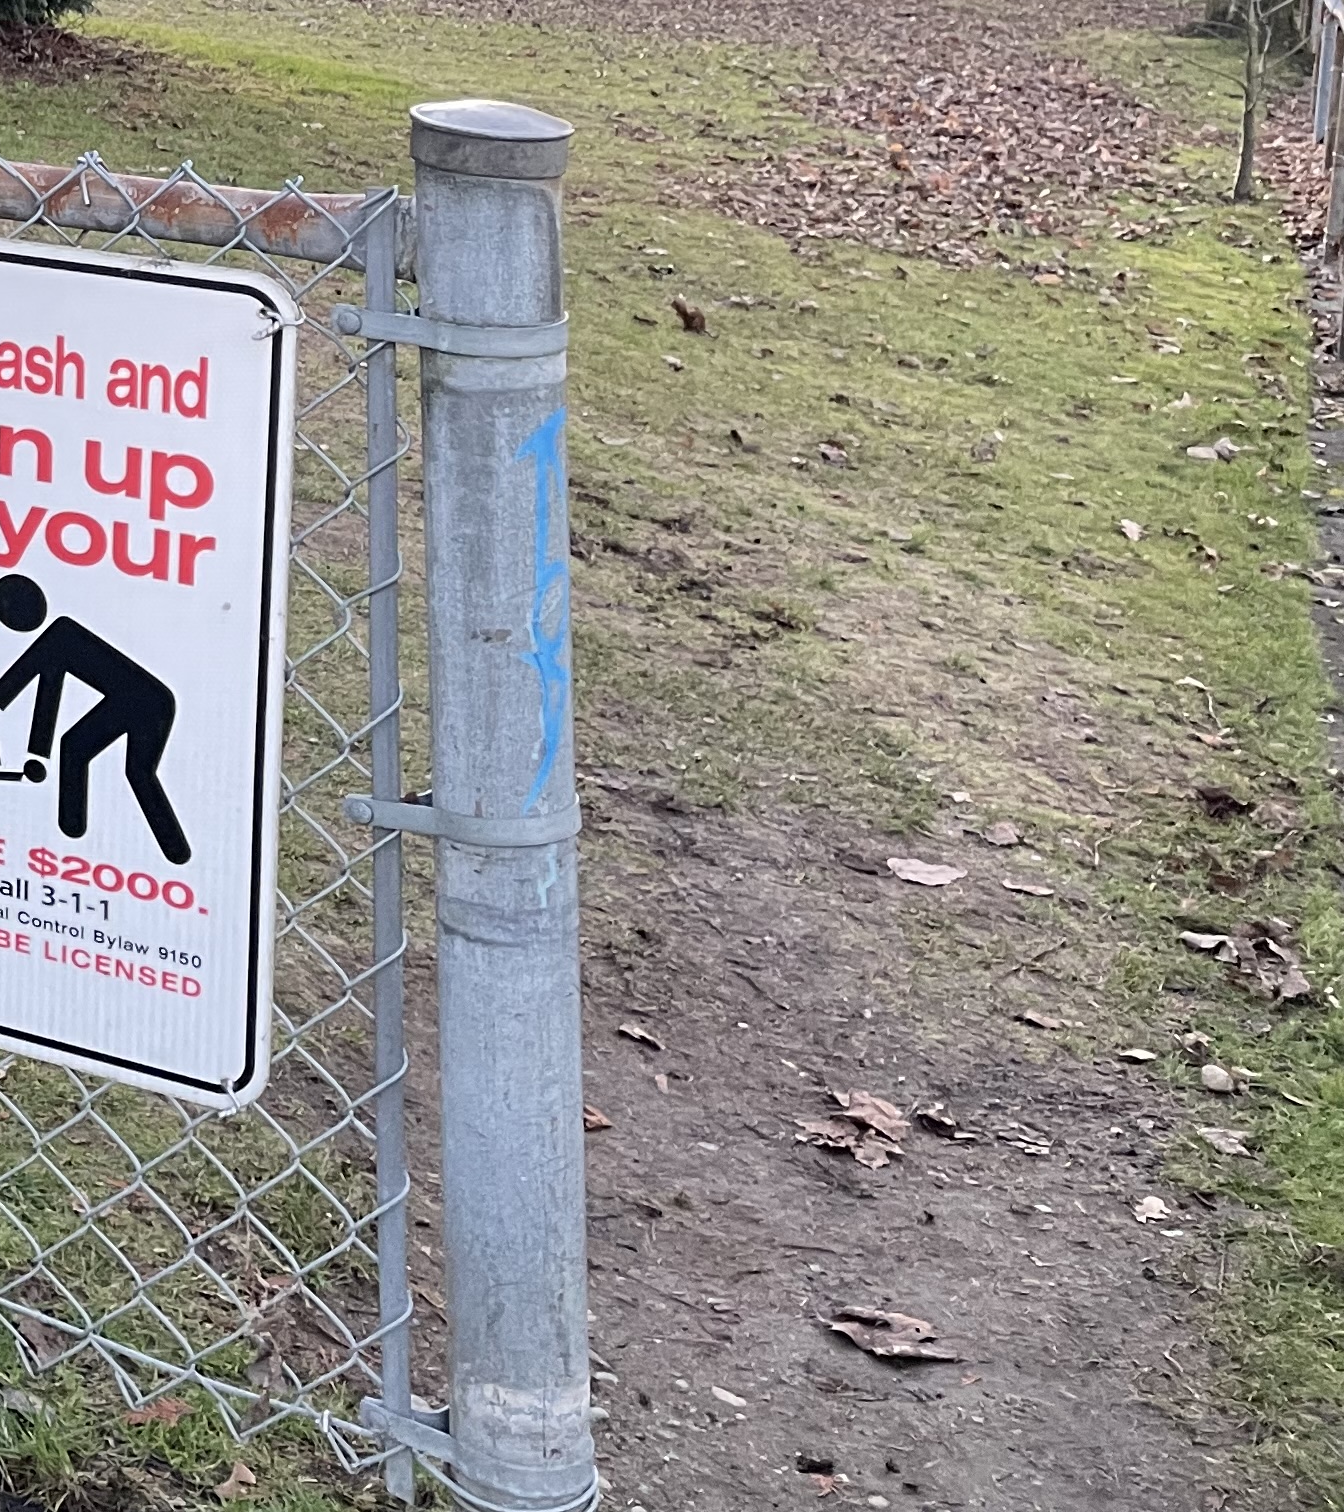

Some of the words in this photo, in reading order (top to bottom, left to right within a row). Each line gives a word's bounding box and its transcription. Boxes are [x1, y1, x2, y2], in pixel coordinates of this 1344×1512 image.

[106, 357, 208, 419] and
[84, 439, 215, 522] up
[27, 847, 209, 916] $2000.
[41, 885, 111, 921] 3-1-1
[17, 911, 85, 940] Control
[93, 929, 150, 956] Bylaw
[158, 946, 202, 969] 9150
[44, 941, 202, 999] LICENSED
